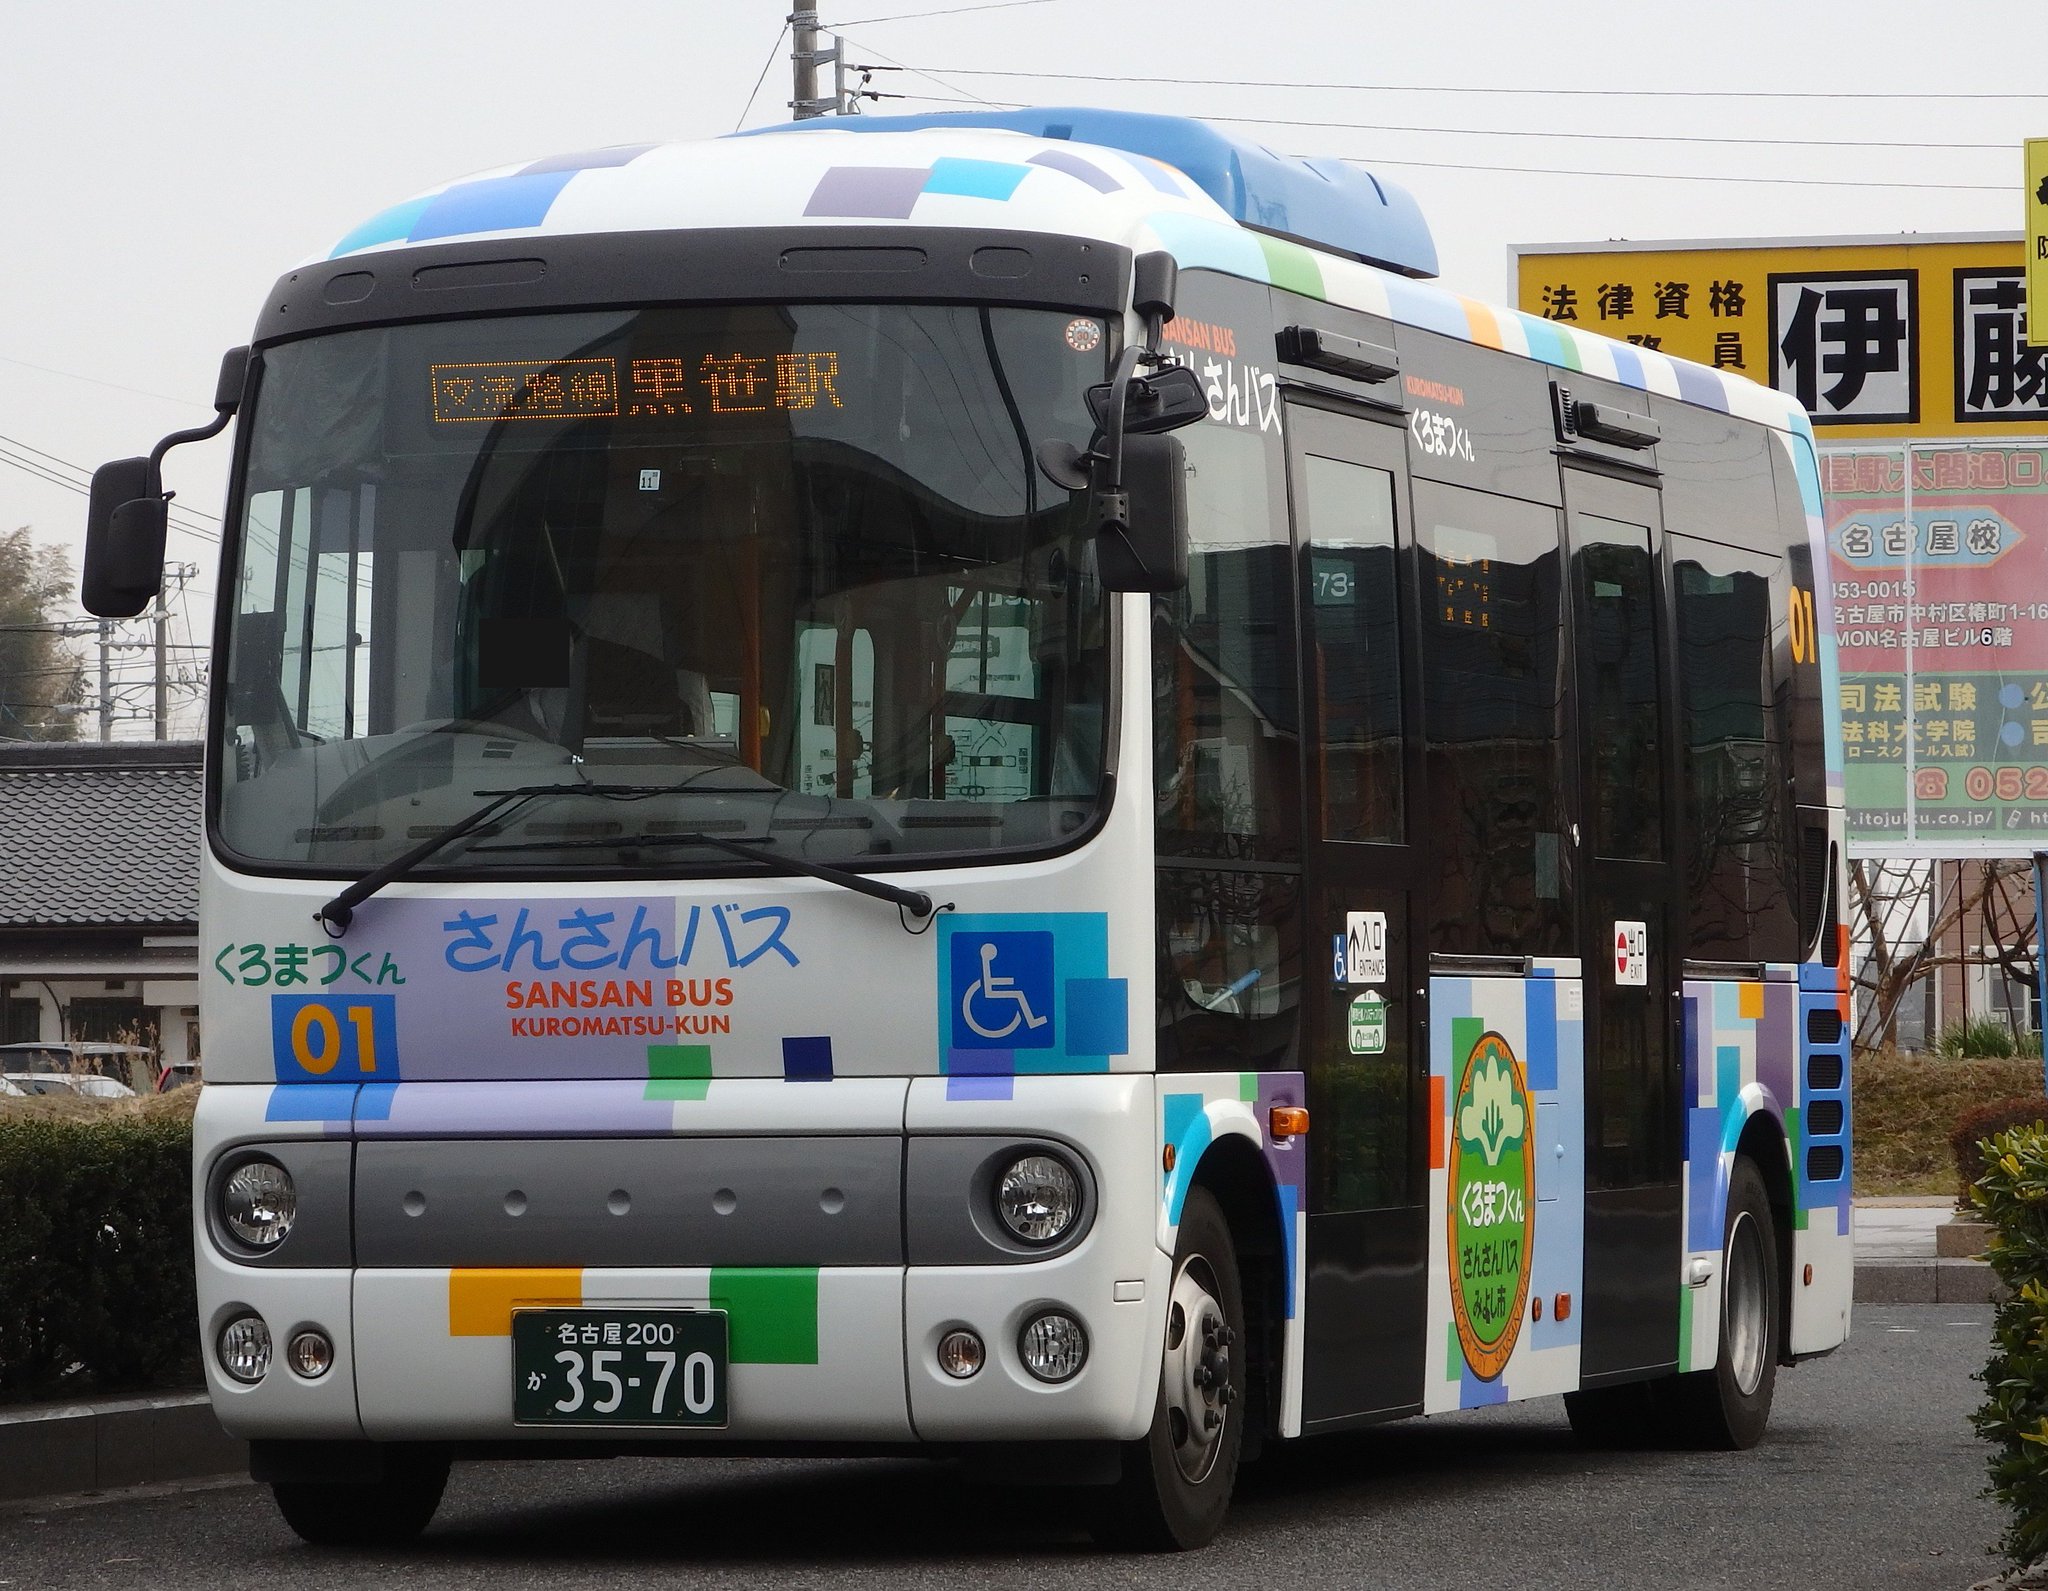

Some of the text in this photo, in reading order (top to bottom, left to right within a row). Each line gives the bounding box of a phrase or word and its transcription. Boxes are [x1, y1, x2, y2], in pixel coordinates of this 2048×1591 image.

[1542, 281, 1747, 321] 法律資格
[1212, 324, 1237, 358] BUS
[443, 352, 844, 415] 交流路線 黒笹駅
[1411, 408, 1475, 462] くろまつくん
[1843, 518, 2000, 556] 名古屋校
[1788, 585, 1815, 664] 01
[1840, 682, 1976, 713] 司法試験
[1842, 719, 1976, 743] 法科大学院
[1965, 766, 2048, 801] 052
[443, 904, 800, 973] さんさんバス
[1361, 921, 1382, 952] 入口
[1628, 929, 1644, 957] 出口
[214, 942, 406, 987] くろまつくん
[1359, 958, 1385, 976] ENTRANCE
[1630, 963, 1642, 979] EXIT
[506, 977, 734, 1010] SANSAN BUS
[291, 1002, 376, 1074] 01
[511, 1014, 731, 1037] KUROMATSU-KUN
[1462, 1181, 1525, 1227] くろまつくん
[1463, 1239, 1519, 1280] さんさんバス
[1473, 1285, 1506, 1325] みよし市
[557, 1322, 674, 1345] 名古屋 200
[527, 1350, 715, 1415] か 35-70
